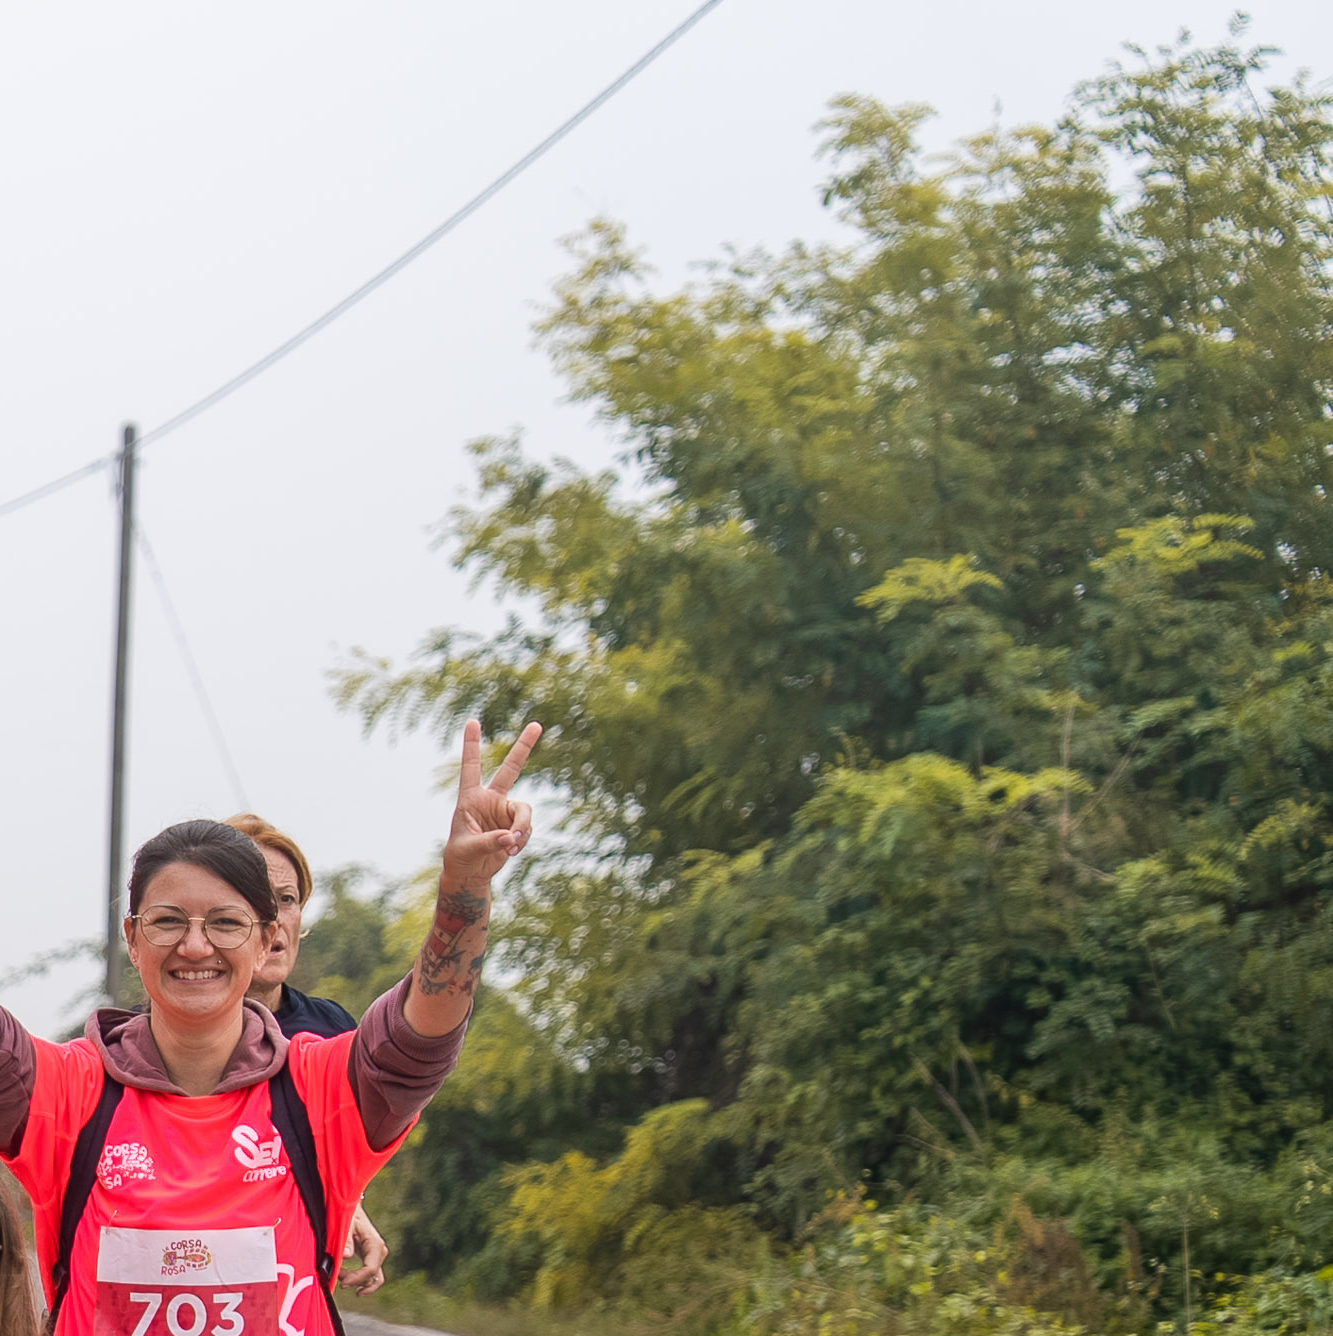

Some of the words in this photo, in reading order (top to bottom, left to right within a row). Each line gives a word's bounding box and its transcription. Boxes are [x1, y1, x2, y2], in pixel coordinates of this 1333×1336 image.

[104, 1143, 148, 1158] CORSA
[170, 1239, 203, 1251] CORSA
[161, 1264, 187, 1276] ROSA
